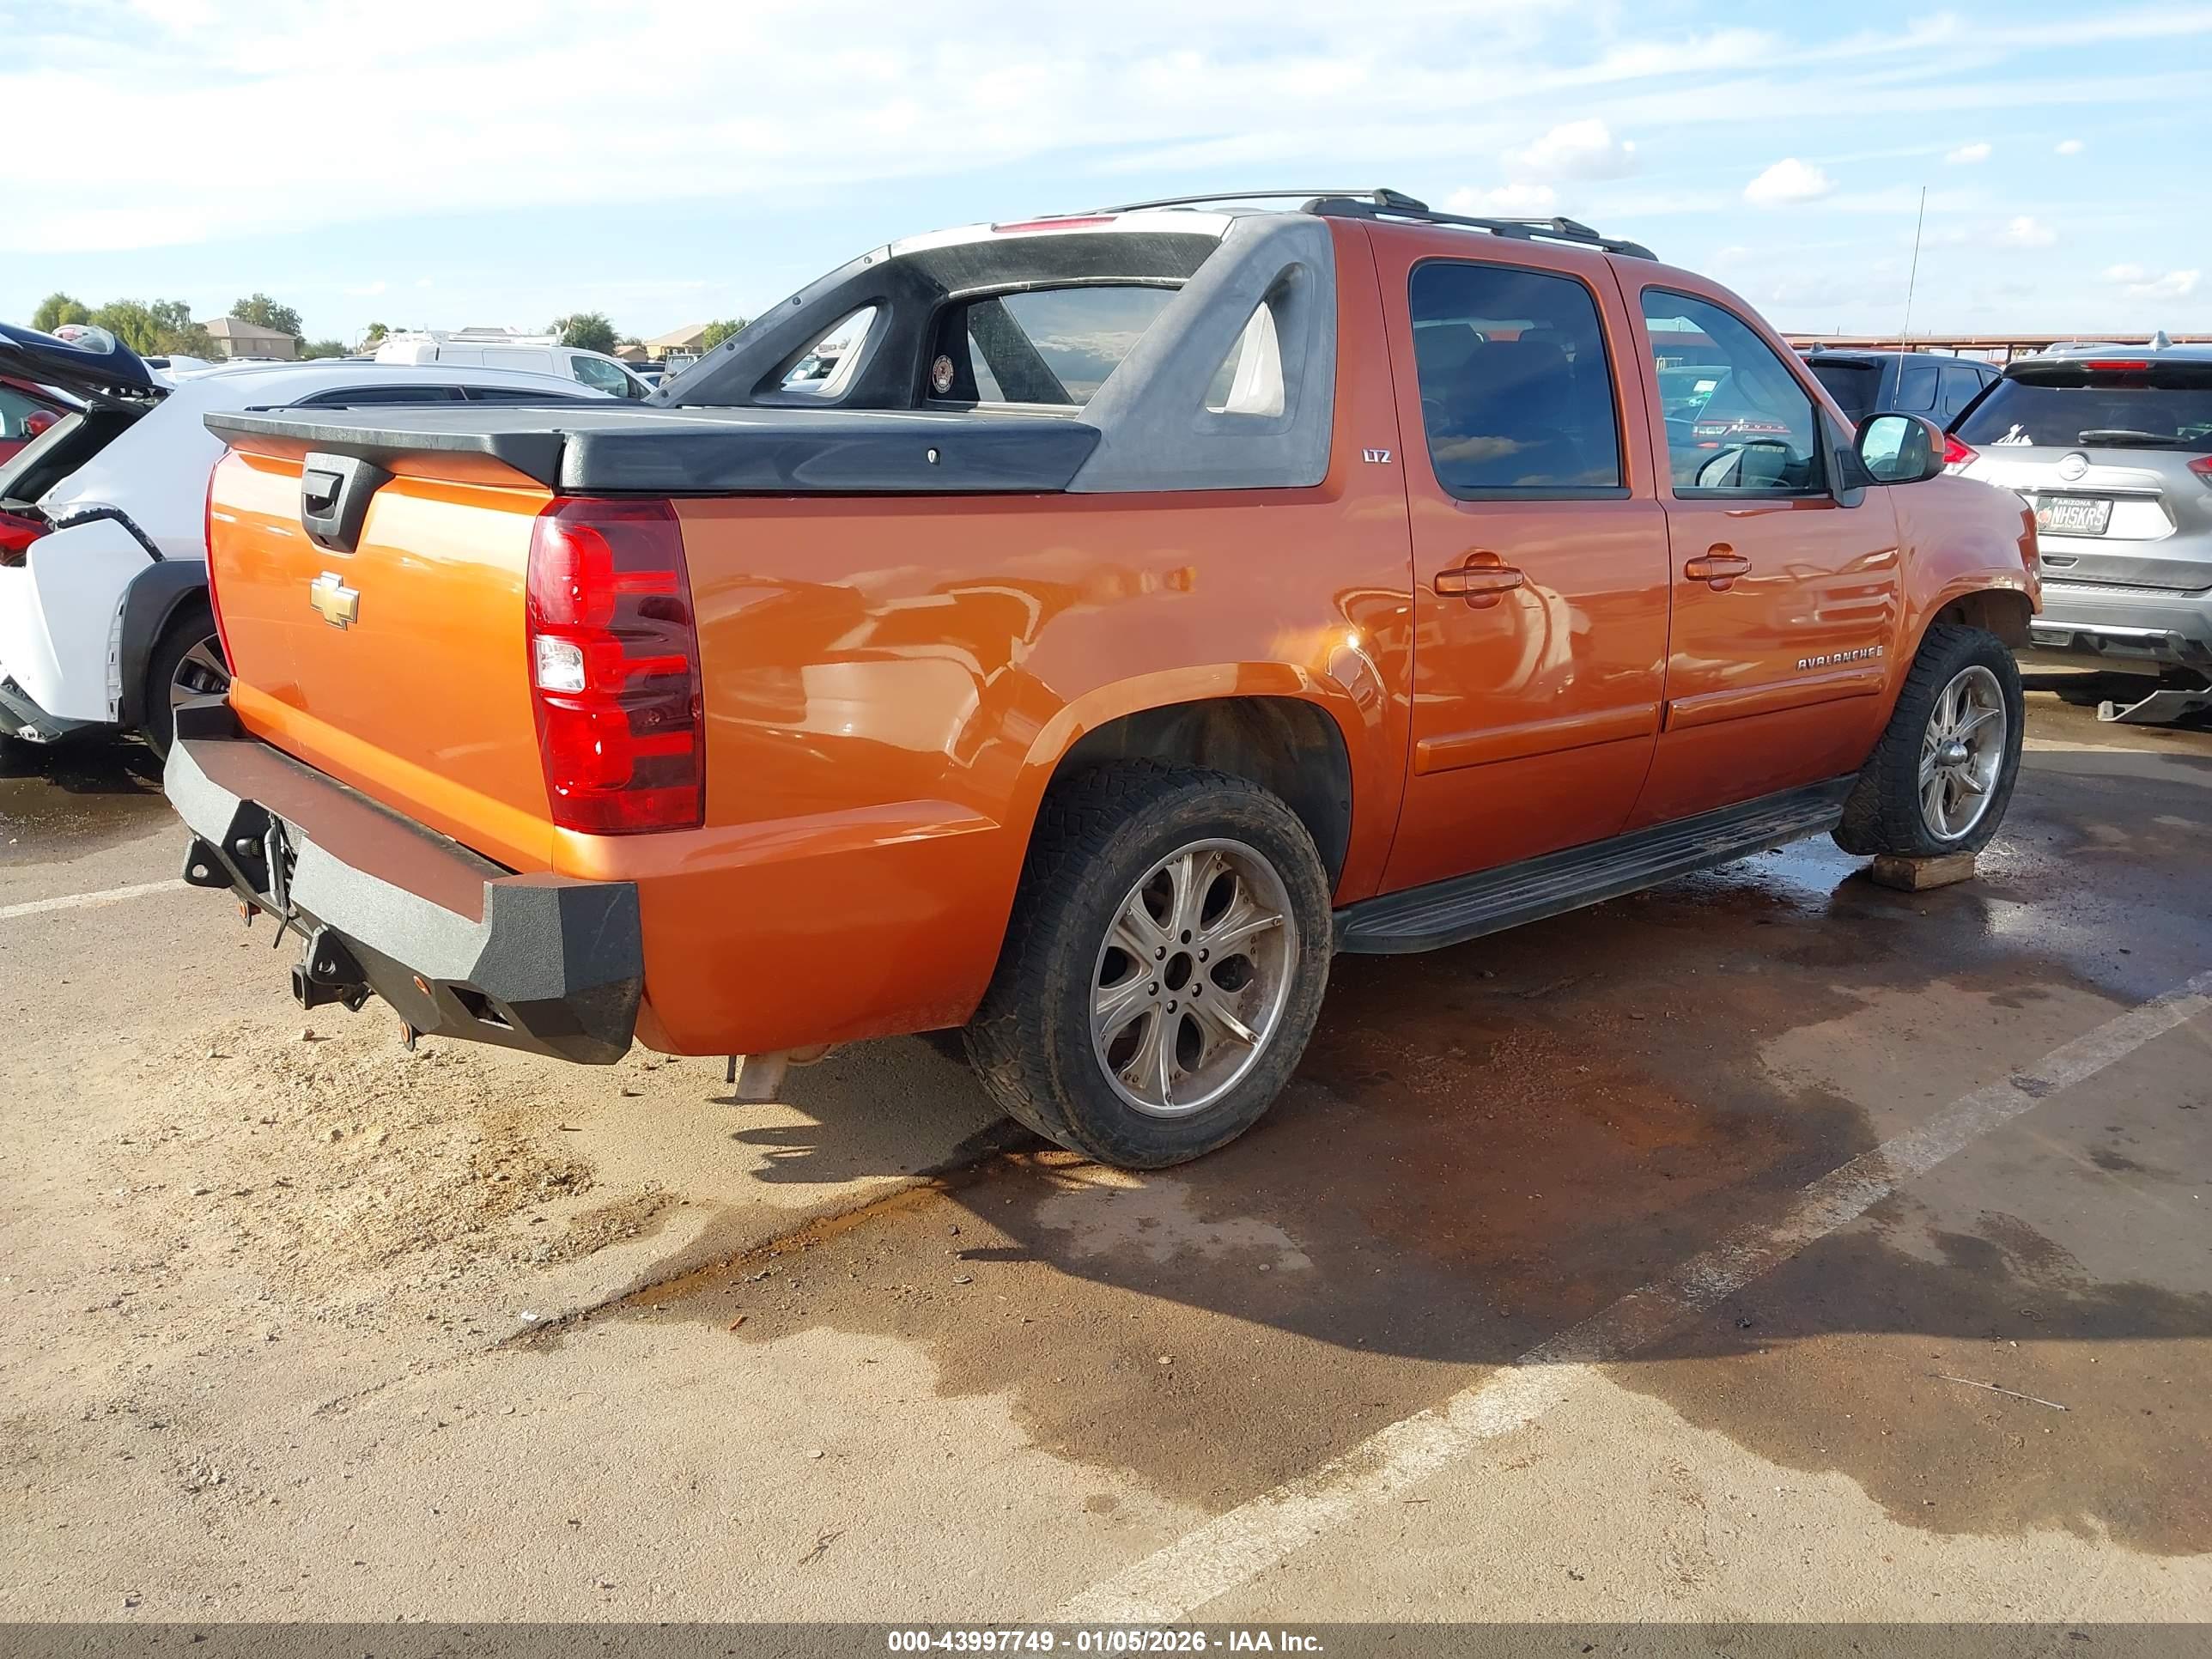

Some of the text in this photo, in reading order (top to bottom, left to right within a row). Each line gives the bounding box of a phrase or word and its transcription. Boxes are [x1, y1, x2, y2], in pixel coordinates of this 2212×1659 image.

[1362, 448, 1392, 464] LTZ
[2053, 506, 2106, 526] NHSKRS
[1796, 647, 1875, 671] AVALANCHE
